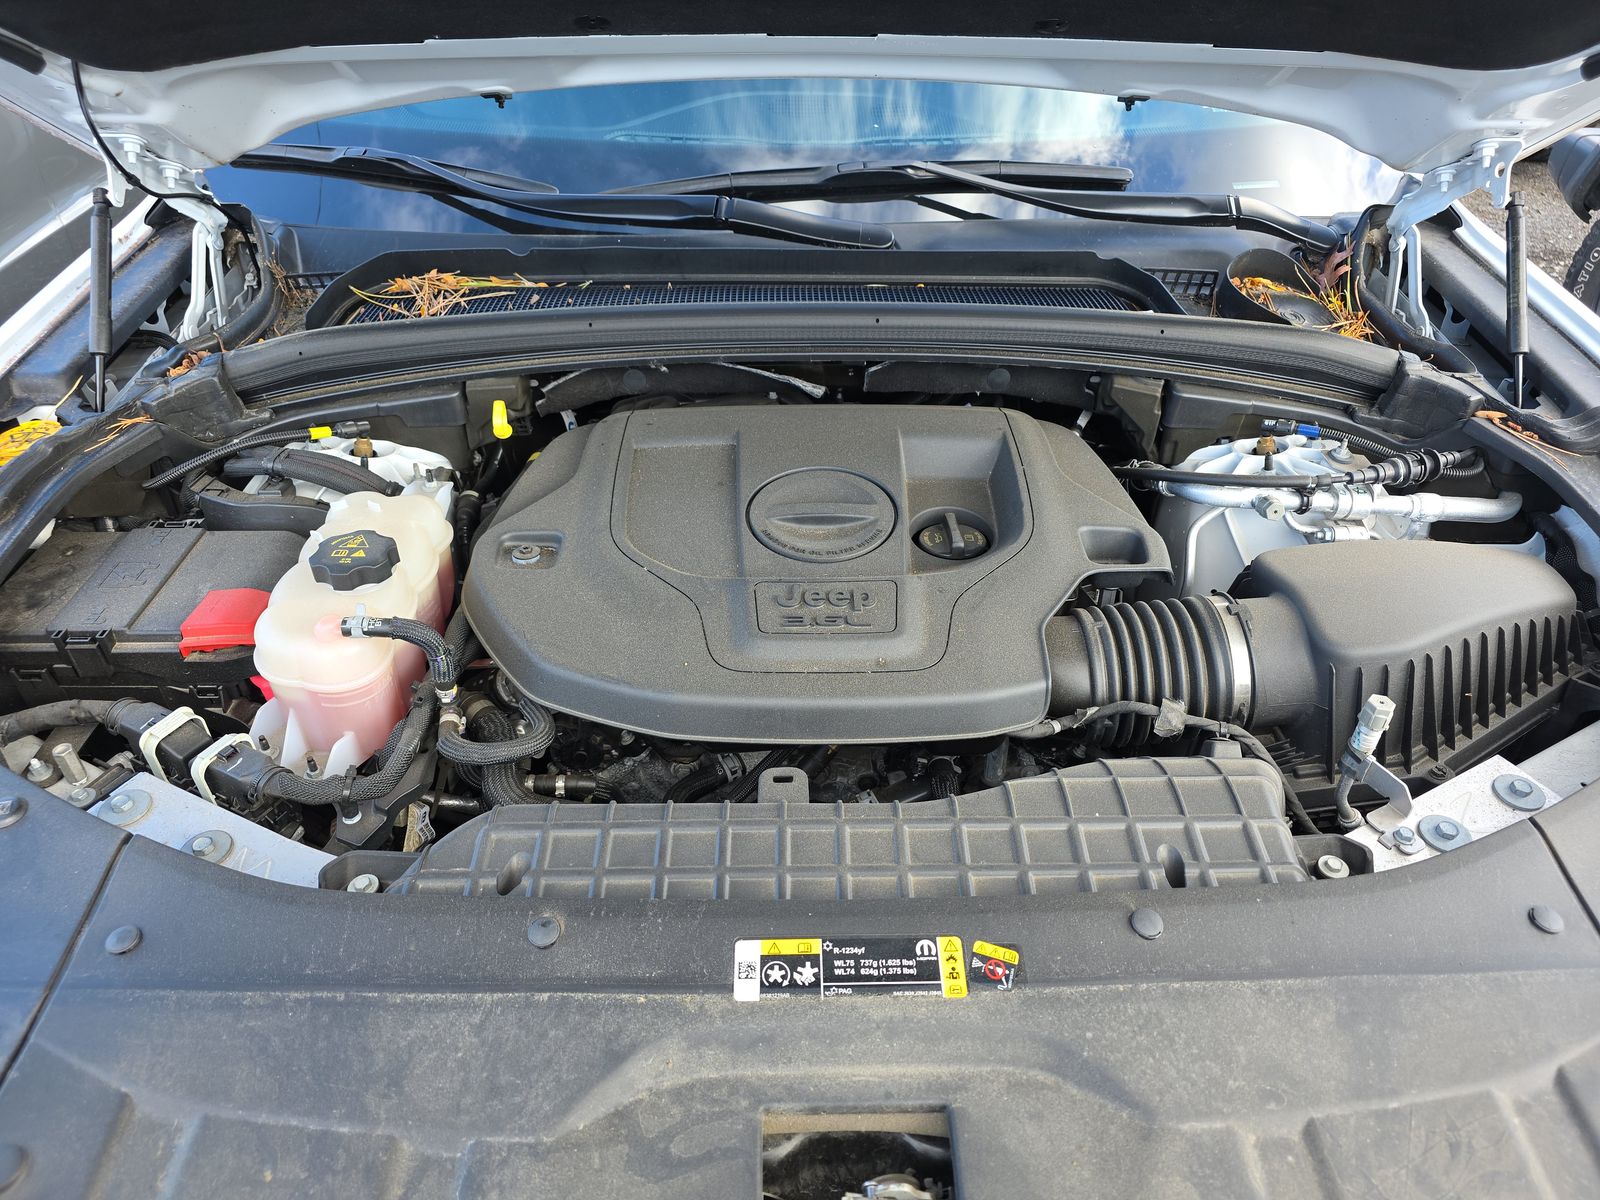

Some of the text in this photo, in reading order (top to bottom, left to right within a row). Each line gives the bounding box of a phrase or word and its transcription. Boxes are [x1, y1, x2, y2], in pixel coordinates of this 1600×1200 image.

[771, 584, 878, 613] Jeep
[782, 615, 873, 628] 3.6L
[833, 946, 866, 955] R-1234yf
[833, 958, 917, 968] WL75 737g (1.625 lbs)
[834, 966, 917, 976] WL74 624g (1.375 lbs)
